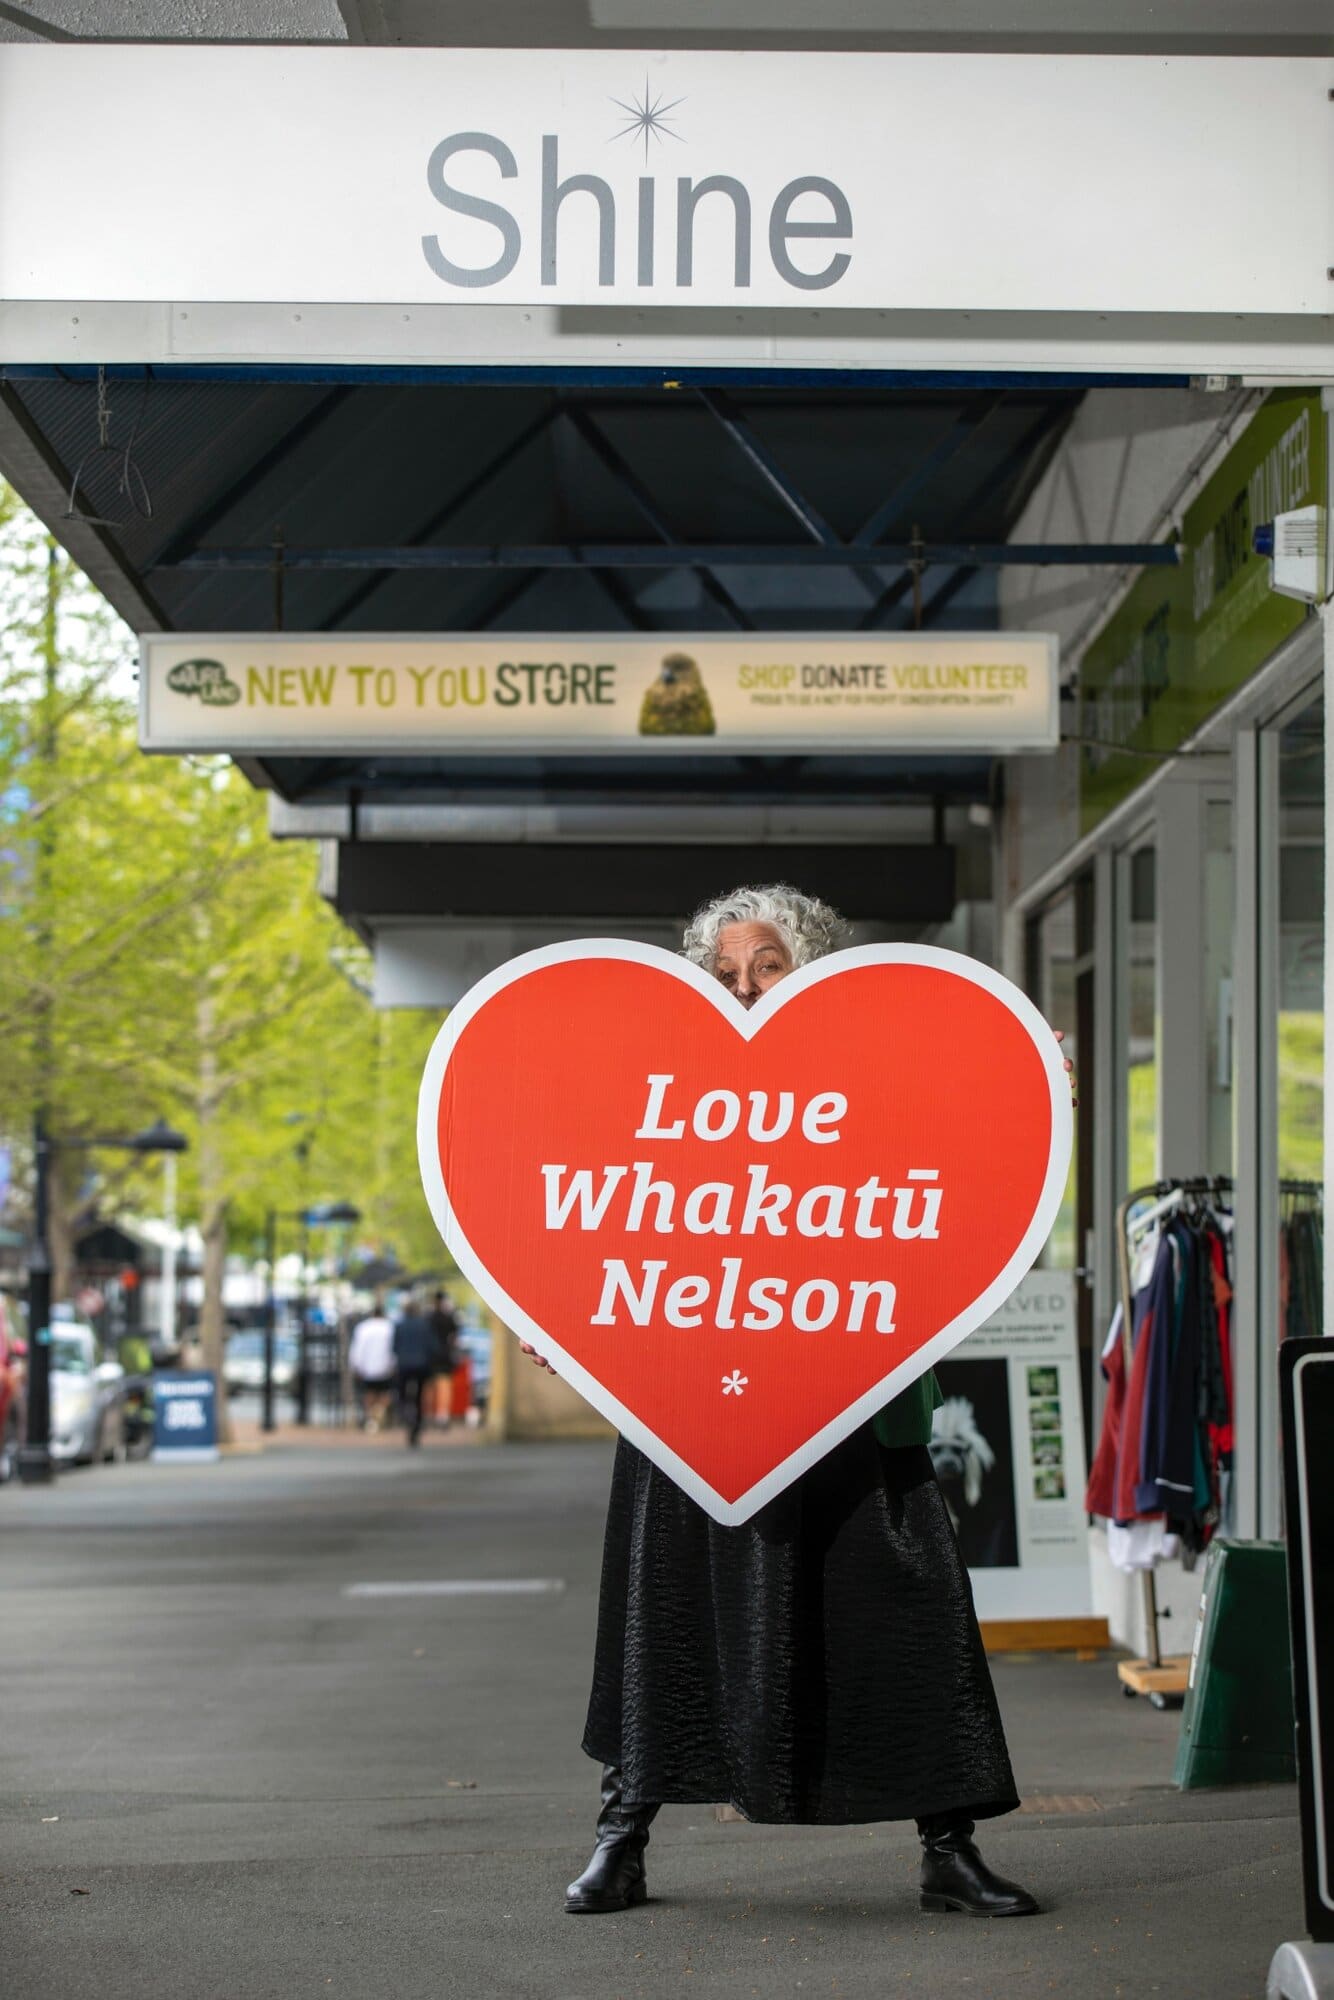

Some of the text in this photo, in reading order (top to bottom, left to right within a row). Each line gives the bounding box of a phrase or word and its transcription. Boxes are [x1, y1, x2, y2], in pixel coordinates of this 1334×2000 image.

[421, 131, 854, 291] Shine
[246, 662, 616, 707] NEW TO YOU STORE
[738, 663, 1028, 689] SHOP DONATE VOLUNTEER
[634, 1074, 848, 1145] Love
[540, 1162, 944, 1240] Whakatū
[590, 1257, 897, 1334] Nelson
